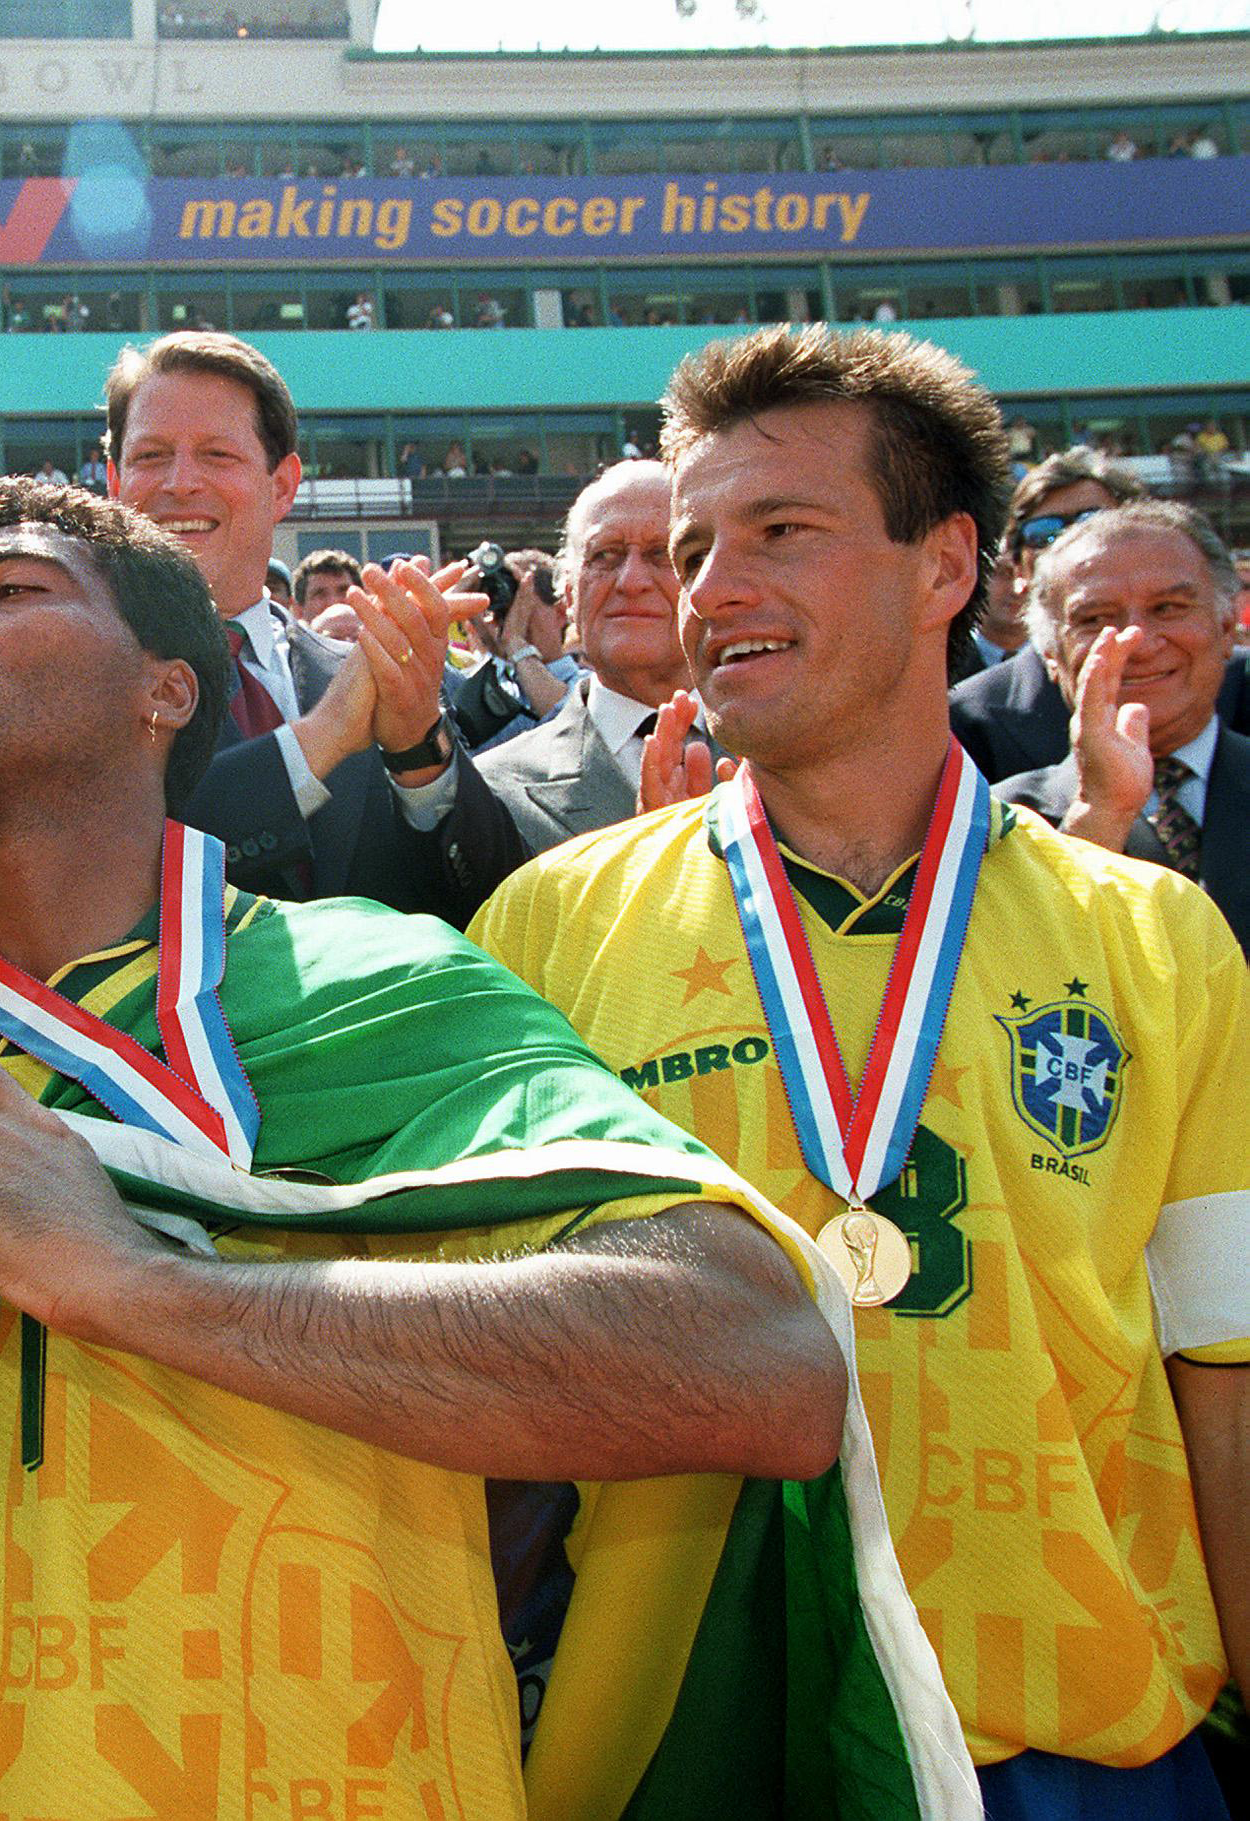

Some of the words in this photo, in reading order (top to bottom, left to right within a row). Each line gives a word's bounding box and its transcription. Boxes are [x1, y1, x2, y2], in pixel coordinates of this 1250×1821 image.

[178, 185, 413, 250] making
[430, 196, 646, 237] soccer
[661, 181, 872, 242] history
[620, 1037, 770, 1090] MBRO
[1046, 1056, 1094, 1085] CBF
[1030, 1153, 1091, 1188] BRASIL
[918, 1444, 1078, 1518] CBF
[2, 1615, 128, 1690] CBF
